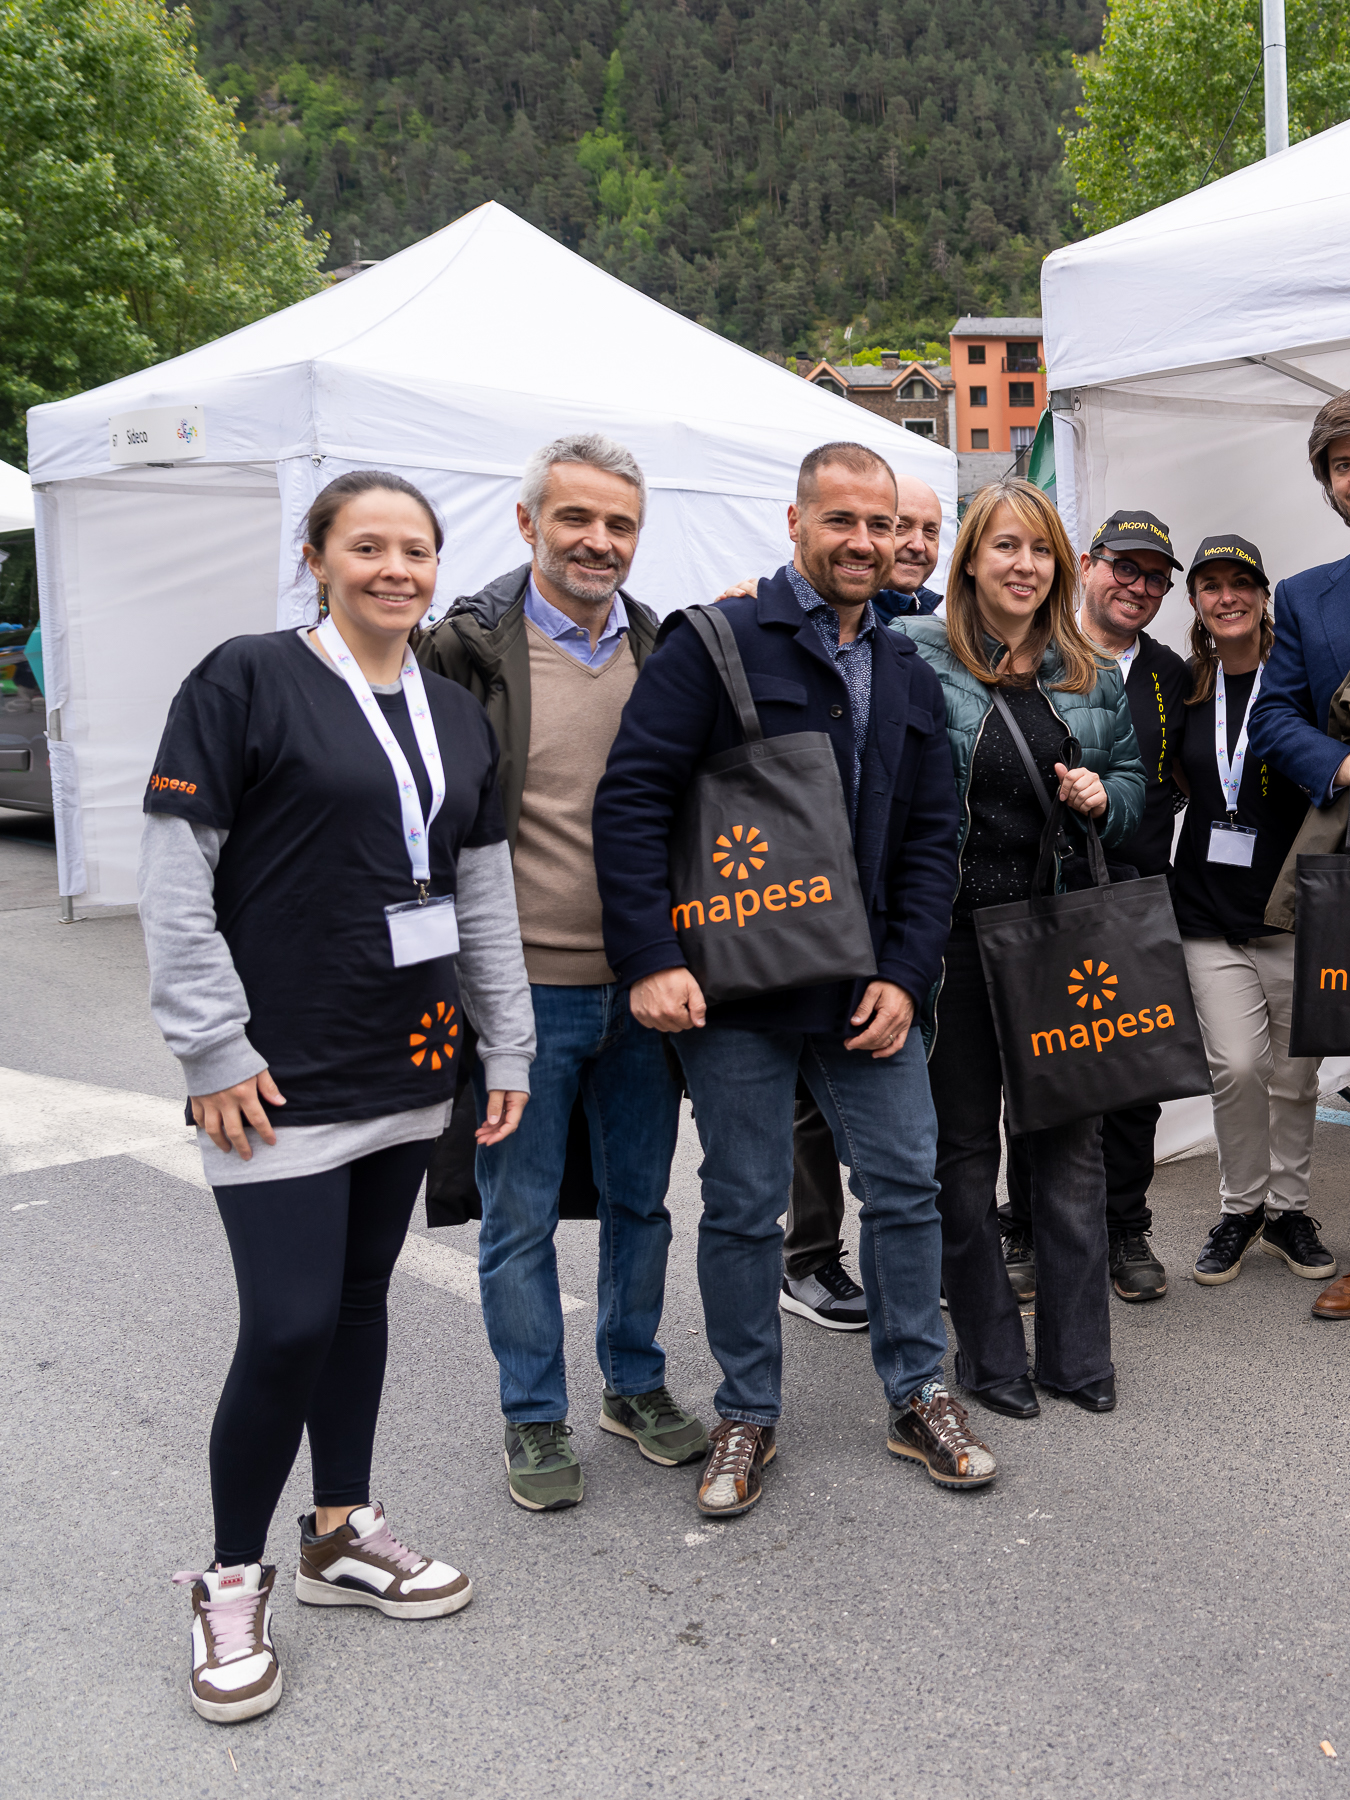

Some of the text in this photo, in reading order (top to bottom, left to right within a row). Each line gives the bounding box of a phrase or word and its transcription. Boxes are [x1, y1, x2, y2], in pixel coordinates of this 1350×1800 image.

[1118, 521, 1169, 544] VAGON TRANS
[1204, 546, 1234, 557] VAGON
[1151, 672, 1167, 783] VAGON TRANS
[1260, 759, 1269, 797] ANS
[671, 875, 833, 931] mapesa
[1030, 1003, 1176, 1057] mapesa
[805, 1279, 824, 1296] OSS
